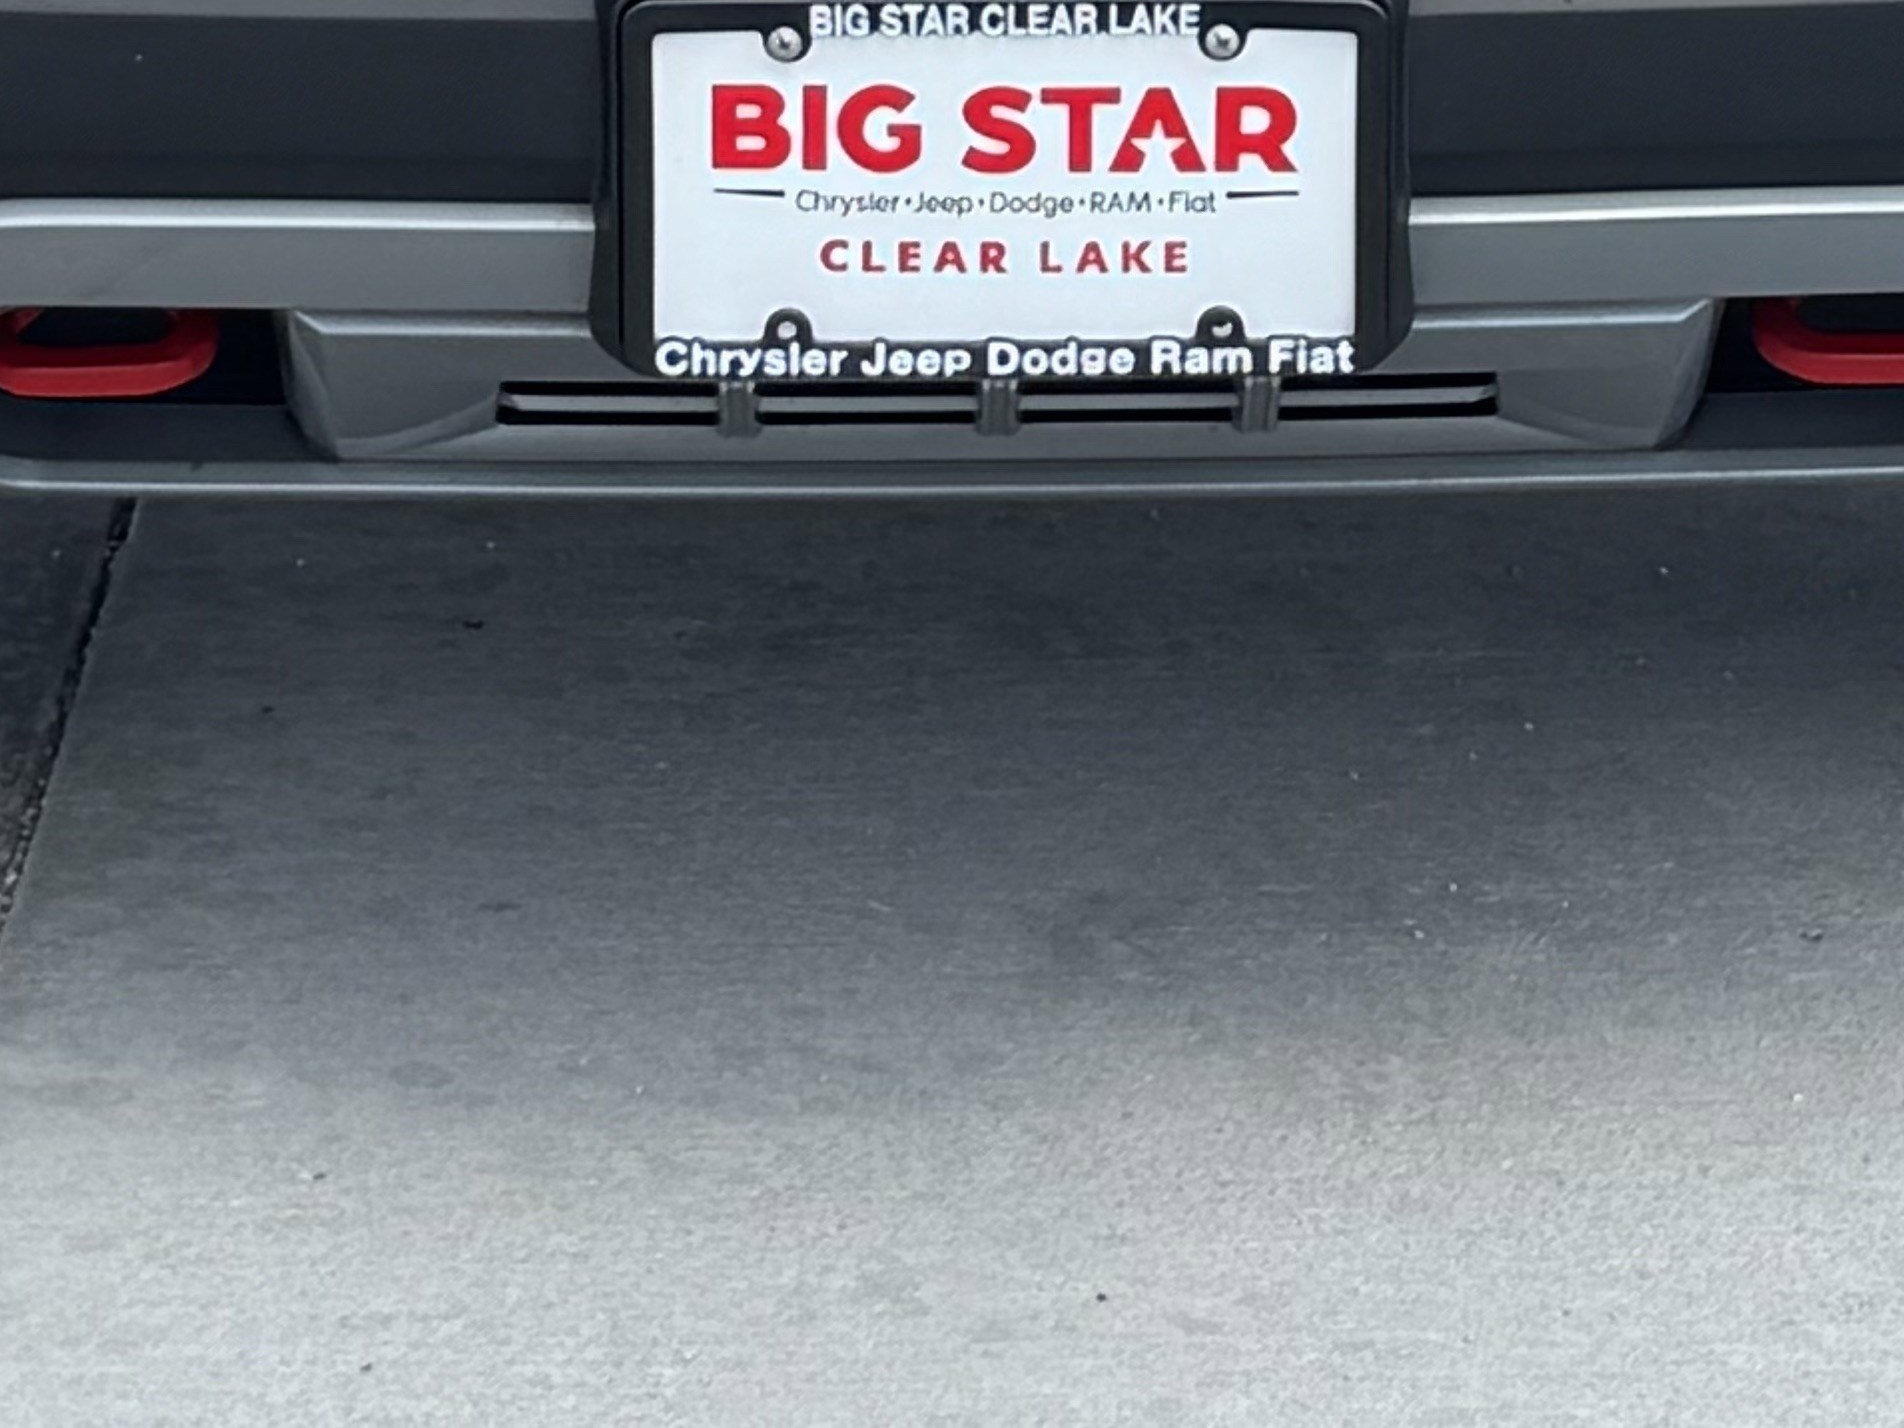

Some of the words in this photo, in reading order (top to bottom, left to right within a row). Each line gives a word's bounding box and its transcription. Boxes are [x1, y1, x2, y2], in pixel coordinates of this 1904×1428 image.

[809, 4, 870, 37] BIG
[880, 4, 970, 37] STAR
[979, 4, 1099, 37] CLEAR
[1109, 4, 1201, 37] LAKE
[711, 83, 922, 171] BIG
[962, 85, 1299, 174] STAR
[796, 190, 901, 217] Chrysler
[913, 190, 974, 219] Jeep
[990, 190, 1074, 219] Dodge
[1090, 192, 1153, 214] RAM
[1169, 190, 1216, 214] Fiat
[819, 239, 1008, 274] CLEAR
[1041, 239, 1190, 274] LAKE
[655, 341, 846, 378] Chrysler
[860, 341, 971, 378] Jeep
[985, 341, 1134, 376] Dodge
[1151, 341, 1253, 376] Ram
[1268, 341, 1355, 374] Fiat
